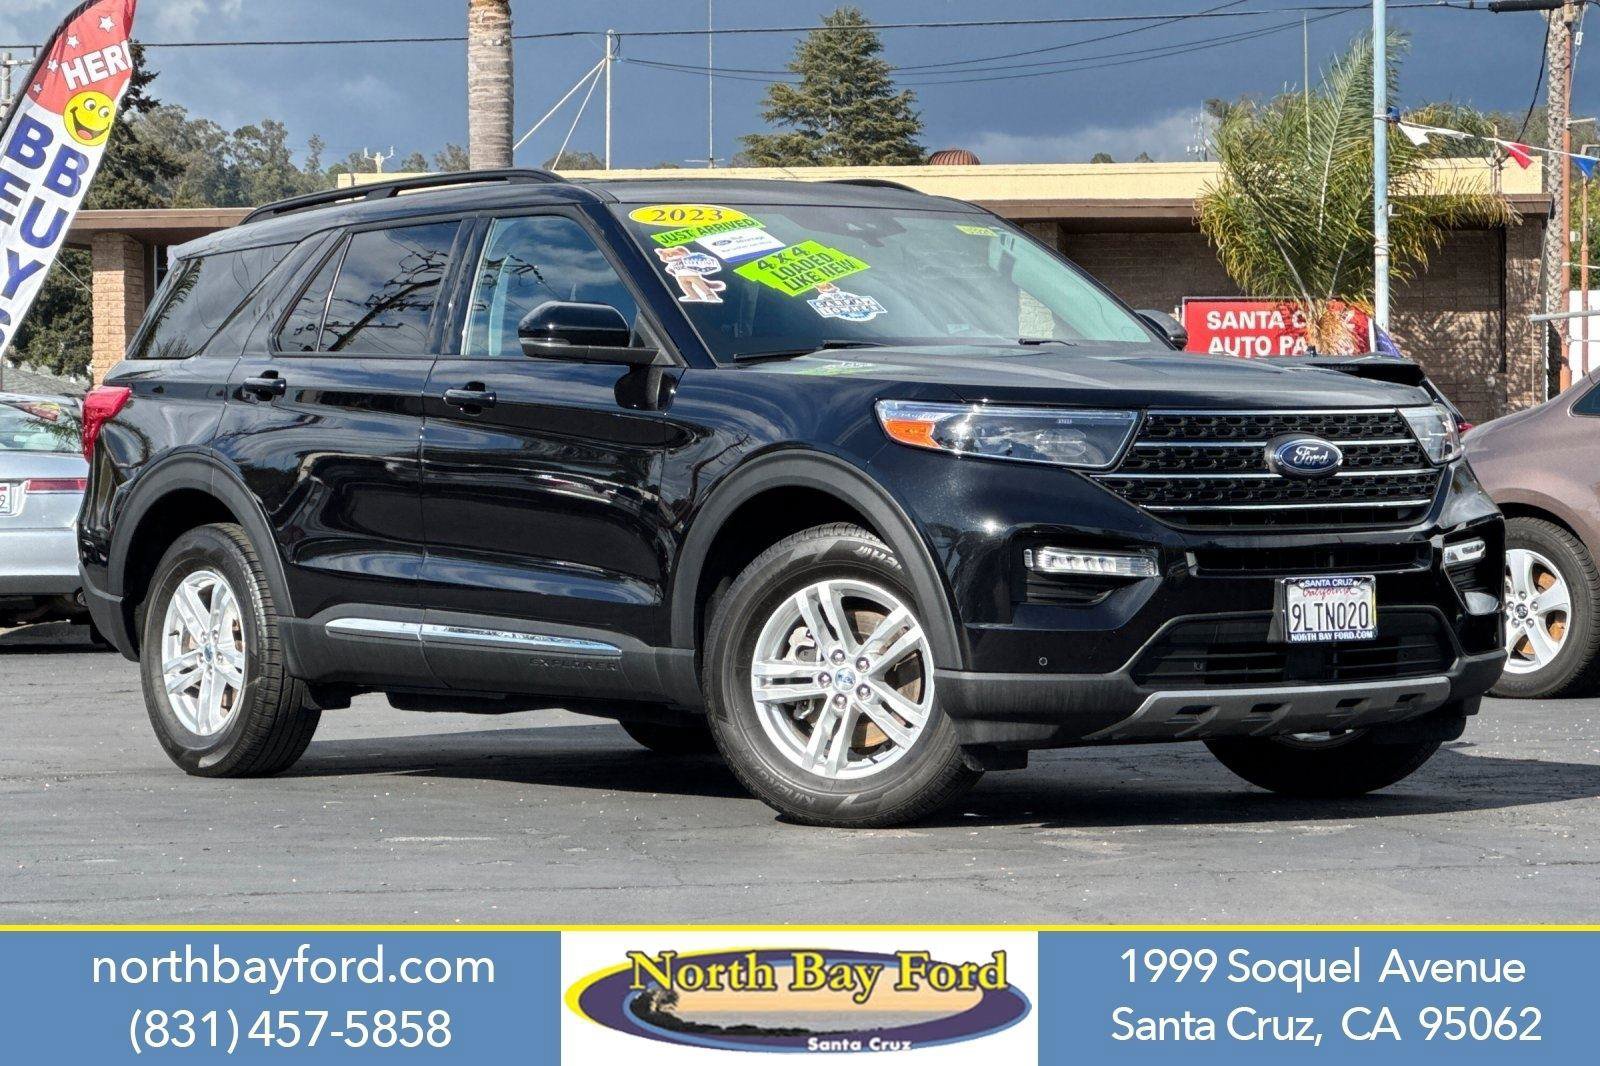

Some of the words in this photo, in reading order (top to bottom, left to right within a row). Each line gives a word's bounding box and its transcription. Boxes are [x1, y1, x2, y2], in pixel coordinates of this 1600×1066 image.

[651, 209, 723, 222] 2023
[660, 228, 694, 244] JUST
[699, 218, 758, 237] ARRIVED
[757, 257, 774, 271] 4
[790, 243, 808, 257] 4
[771, 252, 833, 281] LOADED
[780, 272, 822, 291] LIKE
[820, 259, 856, 279] NEW
[1206, 310, 1286, 330] SANTA
[1208, 335, 1273, 358] AUTO
[1293, 445, 1329, 466] Ford
[1304, 579, 1331, 588] SANTA
[1331, 578, 1354, 587] CRUZ
[1291, 601, 1370, 632] 9LTN020
[1291, 632, 1317, 642] NORTH
[1318, 632, 1333, 641] BAY
[1333, 630, 1374, 640] FORD.COM
